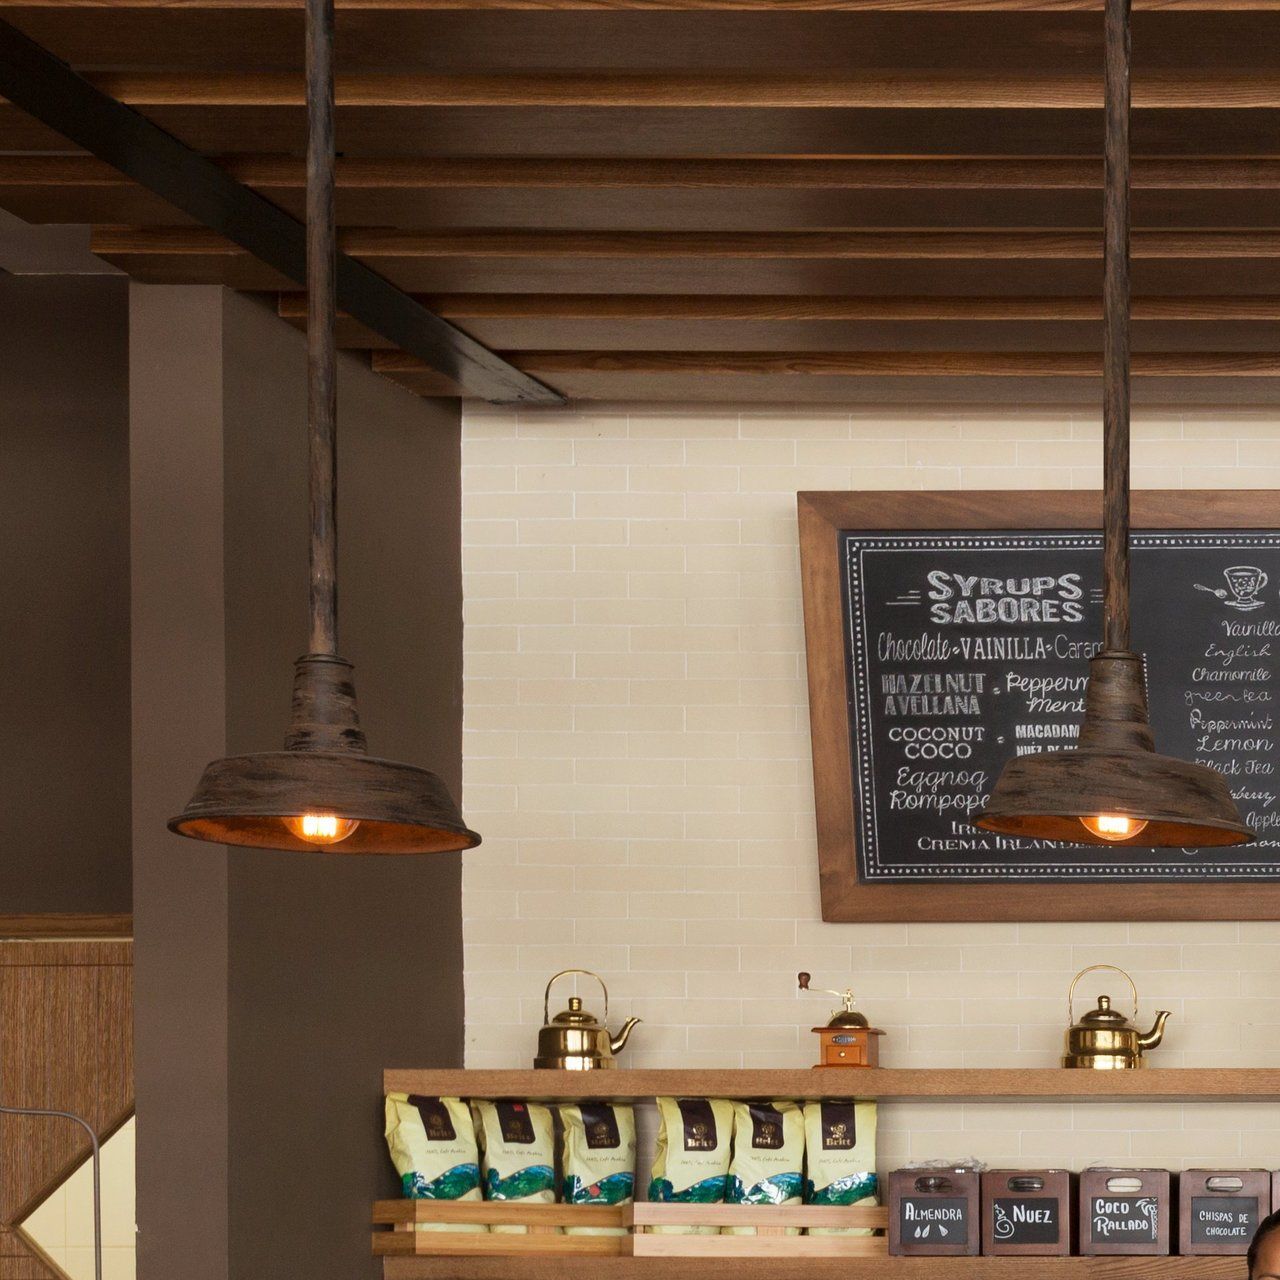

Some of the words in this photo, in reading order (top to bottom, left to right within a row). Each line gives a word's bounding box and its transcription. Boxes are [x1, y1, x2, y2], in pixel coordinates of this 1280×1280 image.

[927, 570, 1083, 600] SYRUPS
[930, 598, 1085, 624] SABORES
[878, 632, 951, 661] Chocolate
[960, 637, 1047, 660] VAINILLA
[1204, 643, 1272, 666] English
[881, 673, 987, 694] HAZELNUT
[1006, 671, 1090, 698] Pepperm
[1192, 667, 1272, 683] Chamomile
[885, 695, 981, 715] AVELLANA
[1026, 697, 1087, 714] Ment
[1184, 689, 1240, 706] green
[1242, 688, 1272, 702] tea
[1189, 708, 1273, 733] Peppermint
[889, 727, 985, 741] COCONUT
[1015, 724, 1080, 739] MACADAM
[905, 742, 972, 760] COCO
[1196, 735, 1273, 752] Lemon
[1245, 759, 1274, 775] Tea
[896, 766, 989, 795] Eggnog
[1229, 785, 1276, 808] berry
[917, 837, 990, 850] CREMA
[825, 1138, 852, 1146] Britt
[904, 1202, 963, 1221] ALMENDRA
[1013, 1205, 1052, 1224] NUEZ
[1095, 1199, 1130, 1215] COCO
[1093, 1216, 1149, 1236] RALLADO
[1199, 1210, 1234, 1224] CHISPAS
[1238, 1212, 1249, 1224] DE
[1205, 1226, 1247, 1237] CHOCOLATE
